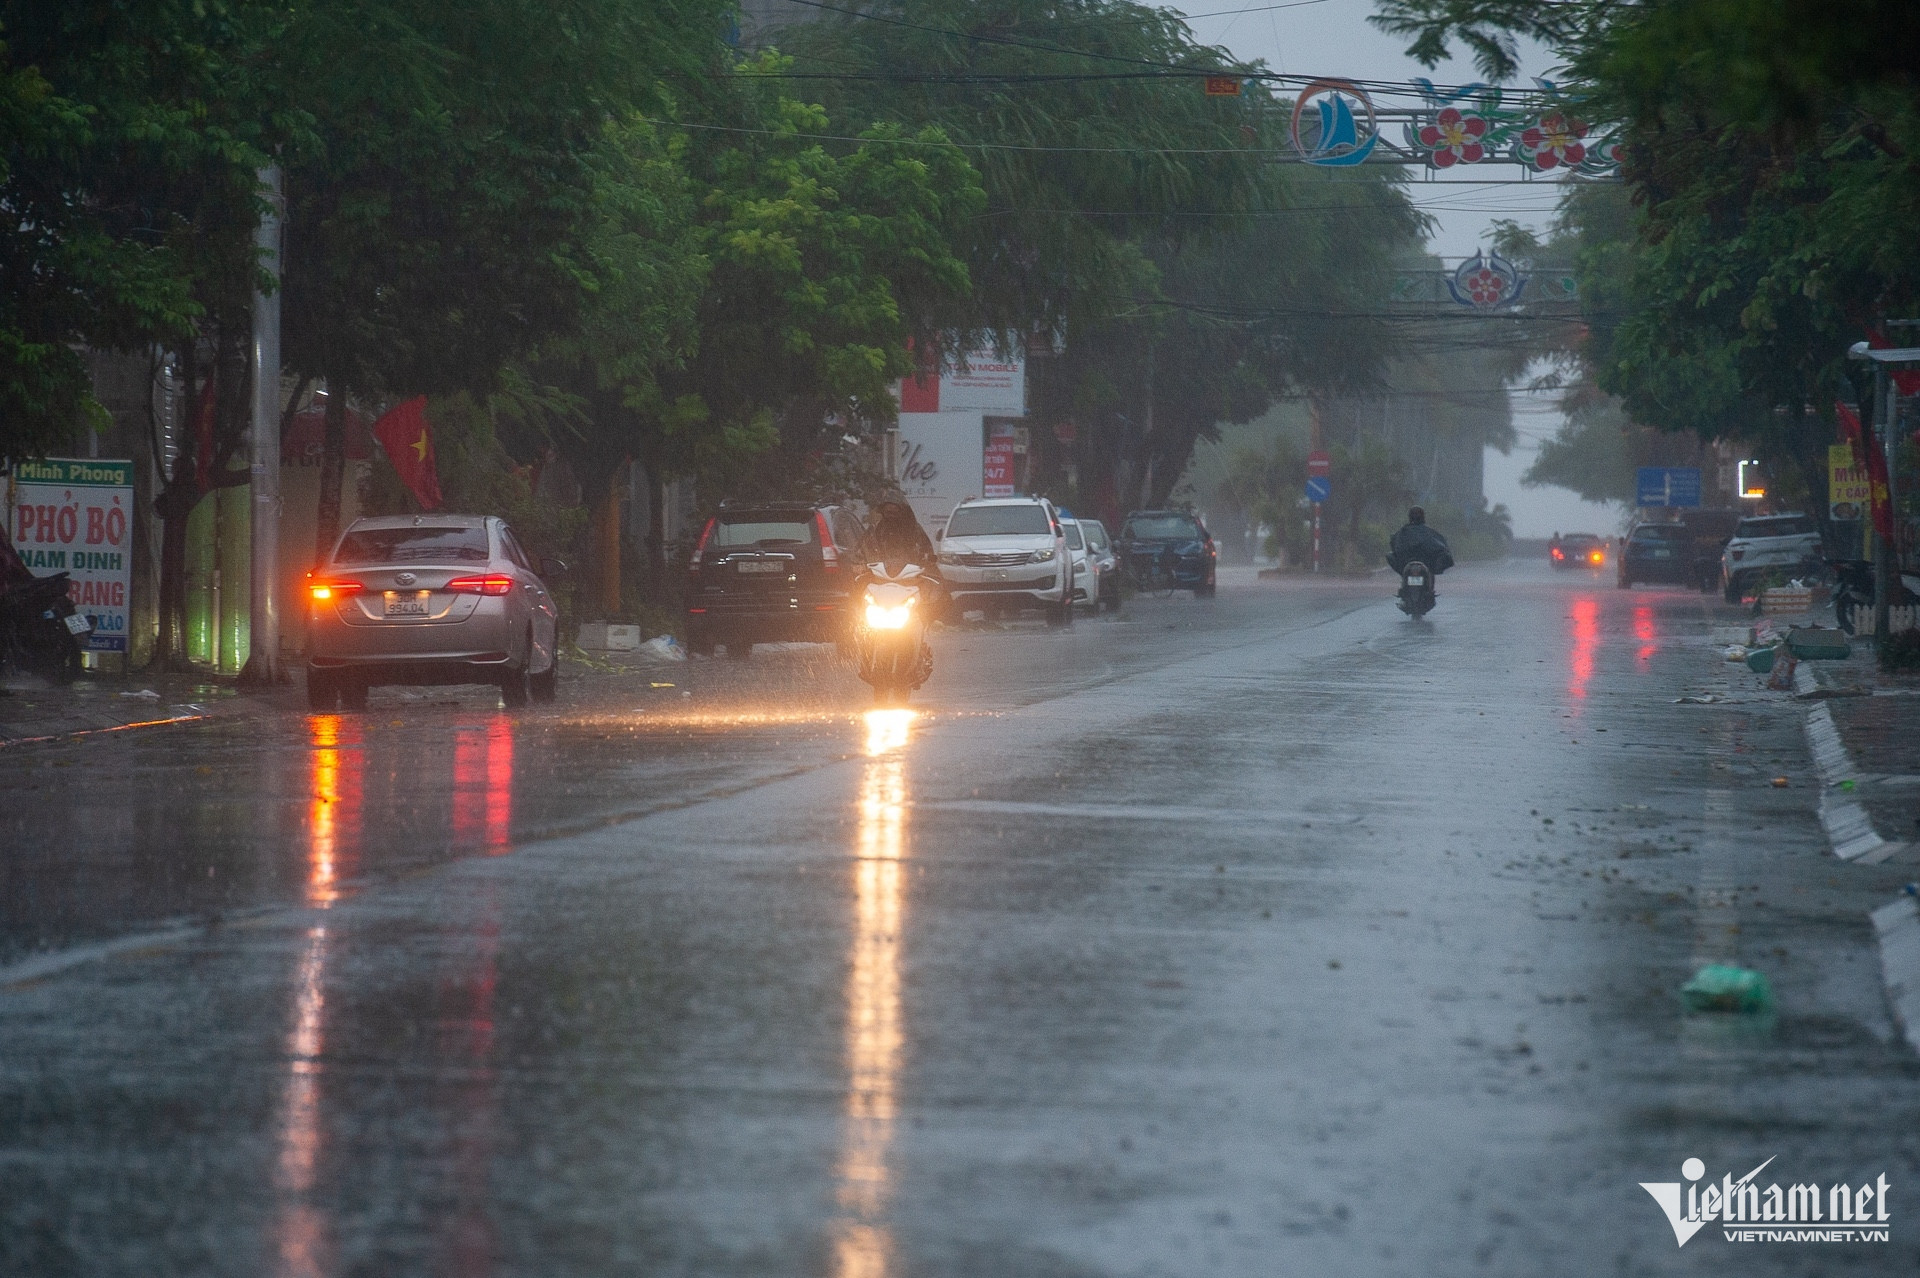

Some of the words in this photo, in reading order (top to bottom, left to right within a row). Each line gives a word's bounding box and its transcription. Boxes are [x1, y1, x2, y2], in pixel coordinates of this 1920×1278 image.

[979, 364, 1018, 372] MOBILE
[20, 463, 63, 479] Minh
[69, 465, 125, 484] Phong
[17, 490, 79, 544] PHỞ
[85, 495, 126, 546] BÒ
[18, 550, 66, 568] NAM
[72, 552, 122, 573] ĐỊNH
